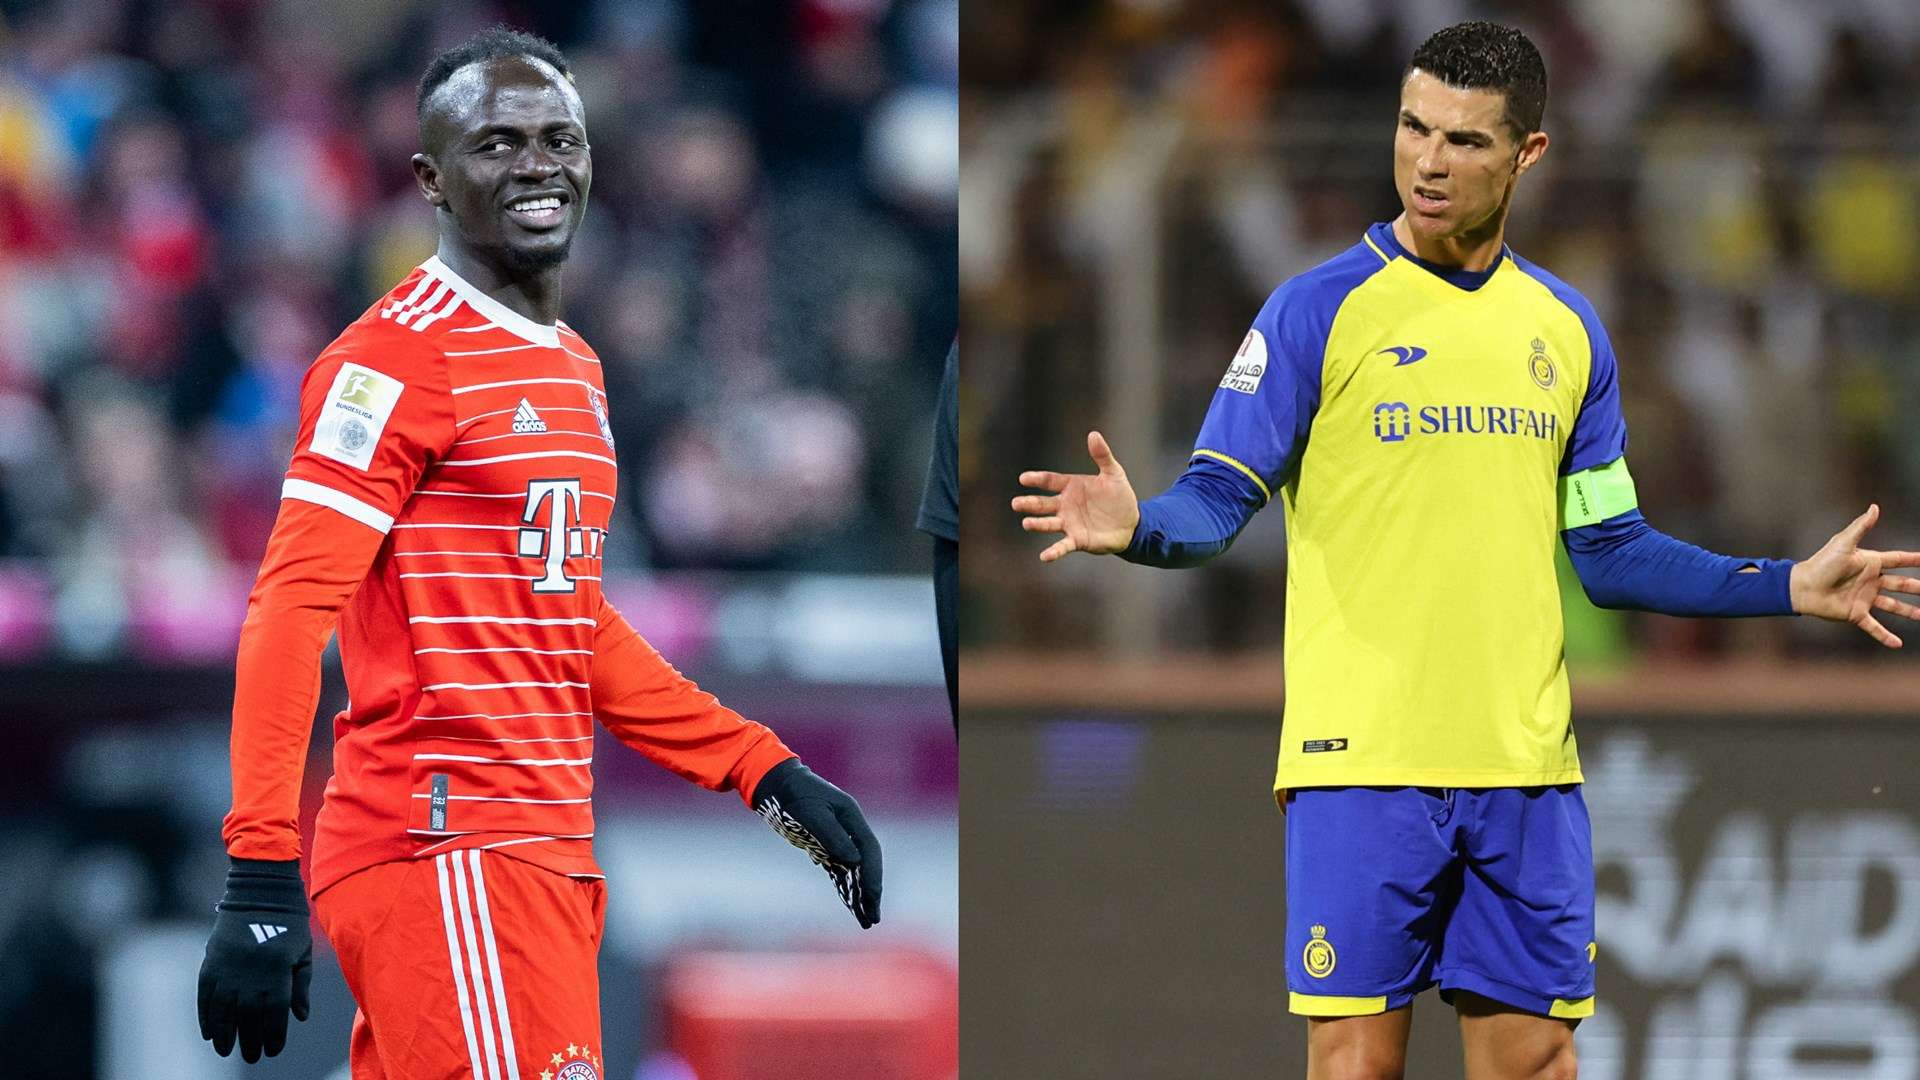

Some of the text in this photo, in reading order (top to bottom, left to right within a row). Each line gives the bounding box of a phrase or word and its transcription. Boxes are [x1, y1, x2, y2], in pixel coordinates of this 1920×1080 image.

[1229, 379, 1255, 392] PIZZA
[335, 402, 373, 420] BUNDESLIGA
[512, 420, 547, 433] adidas
[1419, 406, 1557, 441] SHURFAH
[520, 478, 582, 594] T
